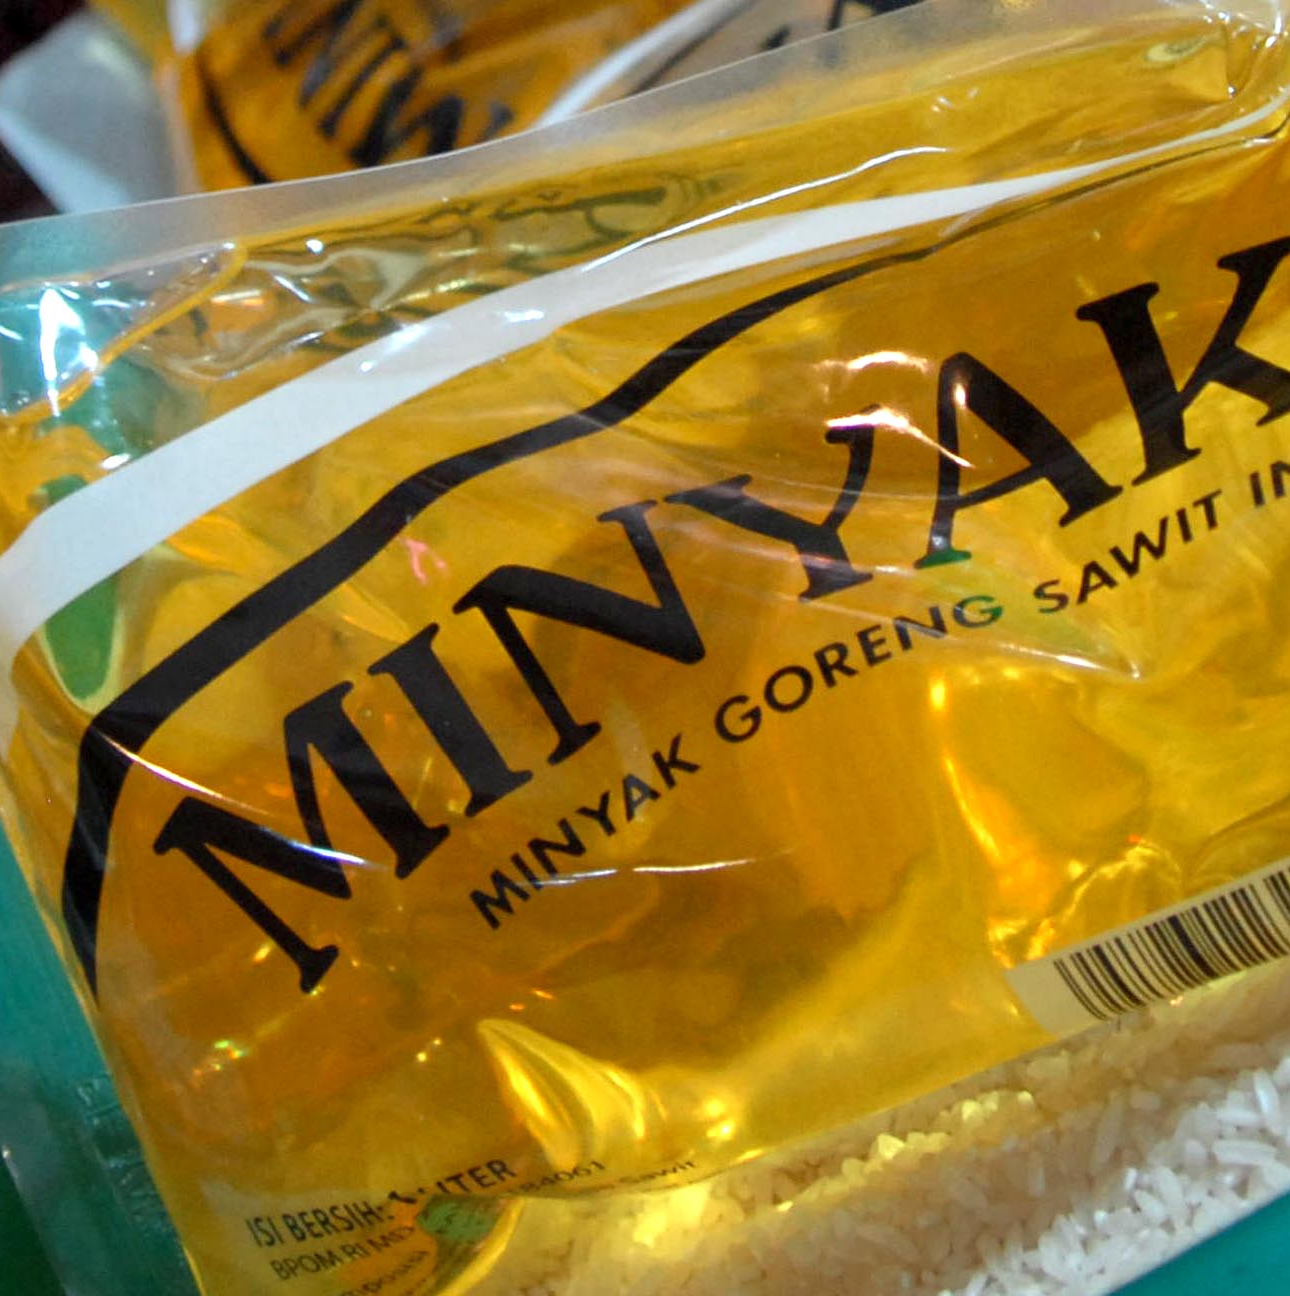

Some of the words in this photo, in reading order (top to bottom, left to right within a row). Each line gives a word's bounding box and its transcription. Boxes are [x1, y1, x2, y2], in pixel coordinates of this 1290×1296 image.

[469, 734, 700, 931] MINYAK
[714, 594, 1005, 745] GORENG
[1031, 489, 1224, 616] SAWIT
[246, 1215, 285, 1249] ISI
[417, 1158, 518, 1196] ITER
